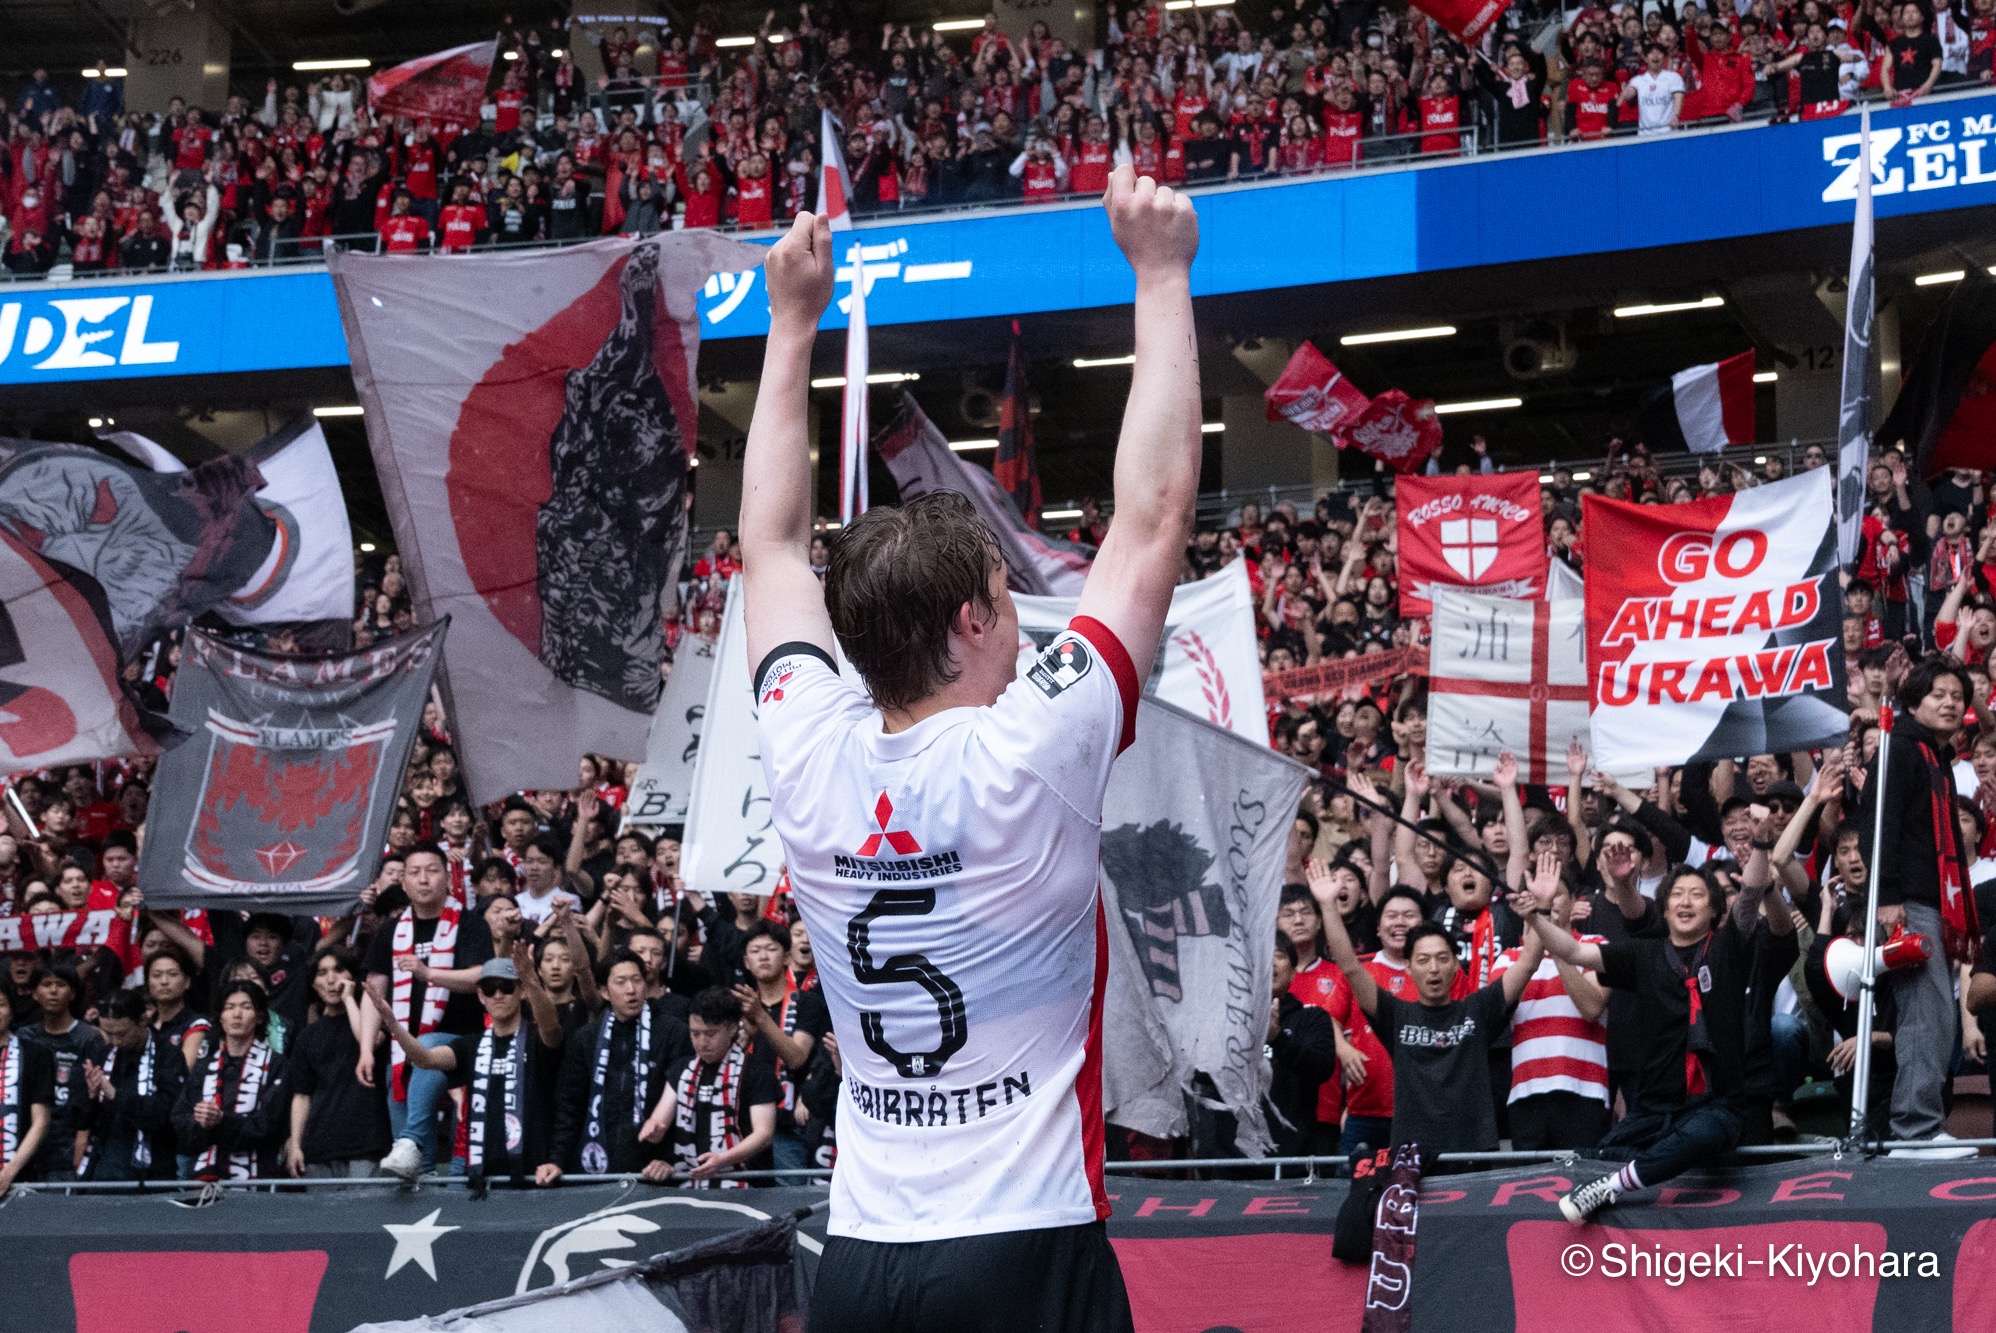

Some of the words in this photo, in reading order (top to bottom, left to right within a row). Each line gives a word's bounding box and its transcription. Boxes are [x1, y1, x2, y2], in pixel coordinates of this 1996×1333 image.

[1906, 120, 1950, 145] FC
[1407, 493, 1463, 529] ROSSO
[1658, 529, 1768, 586] GO
[1600, 573, 1826, 647] AHEAD
[1597, 637, 1837, 707] URAWA
[261, 729, 352, 748] FLAMES
[834, 850, 961, 872] MITSUBISHI
[835, 867, 873, 881] HEAVY
[877, 862, 963, 881] INDUSTRIES
[846, 887, 968, 1079] 5
[1107, 1193, 1319, 1218] HE
[1418, 1172, 1854, 1209] PRDE
